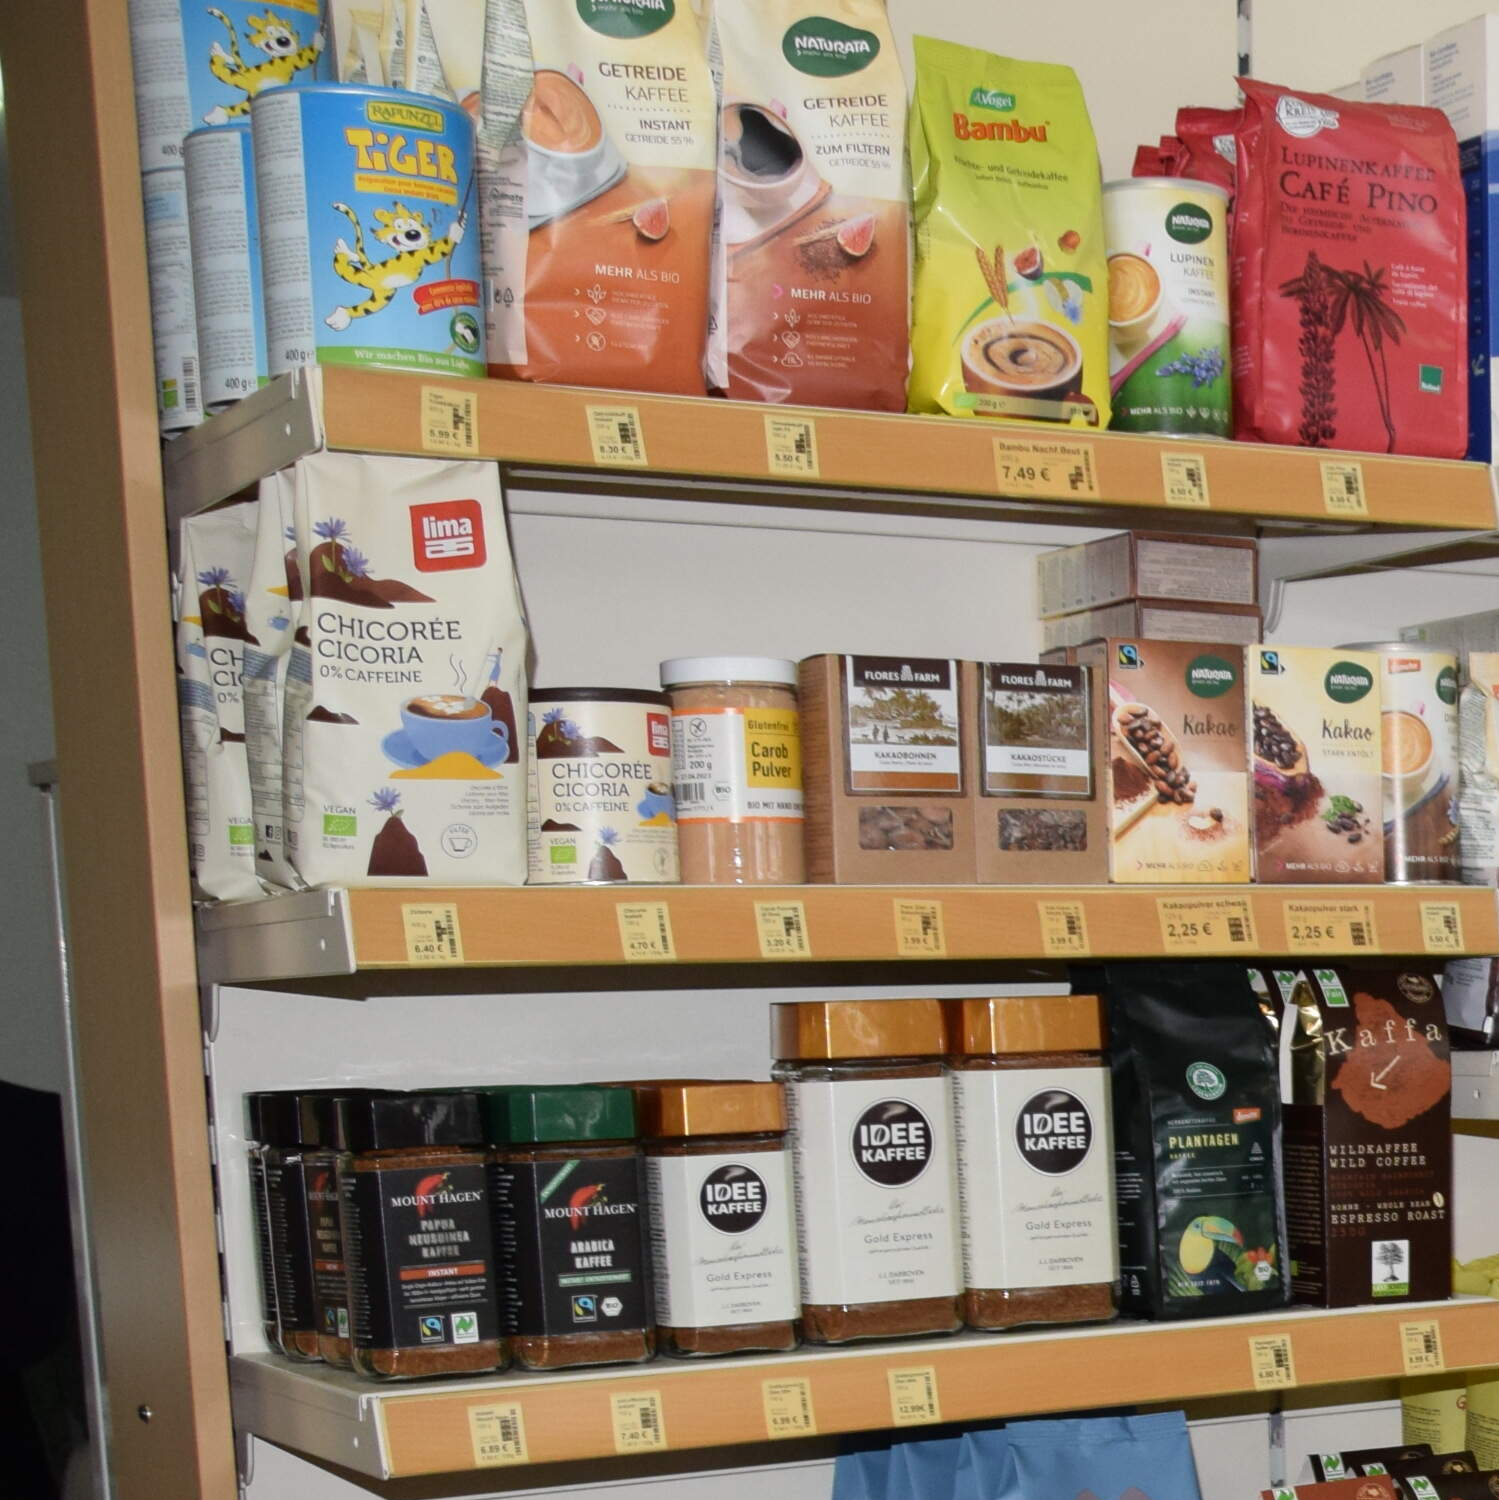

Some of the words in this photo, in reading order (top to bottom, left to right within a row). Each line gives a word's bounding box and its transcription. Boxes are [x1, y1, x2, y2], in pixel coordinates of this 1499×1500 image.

[795, 36, 869, 54] NATURATA
[600, 63, 687, 82] GETREIDE
[625, 87, 688, 103] KAFFEE
[640, 120, 691, 131] INSTANT
[954, 113, 1046, 142] Bambu
[816, 144, 843, 155] ZUM
[846, 144, 890, 156] FILTERN
[1282, 147, 1436, 182] LUPINENKAFFEE
[1280, 172, 1350, 205] CAFÉ
[1368, 182, 1437, 214] PINO
[1170, 253, 1214, 267] LUPINEN
[595, 265, 632, 278] MEHR
[637, 270, 658, 280] ALS
[661, 272, 679, 283] BIO
[1002, 466, 1035, 481] 7,49
[1040, 468, 1050, 481] €
[423, 514, 472, 538] lima
[317, 613, 461, 642] CHICORÉE
[318, 639, 423, 664] CICORIA
[319, 665, 342, 681] 0%
[344, 667, 422, 683] CAFFEINE
[865, 671, 900, 682] FLORES
[914, 672, 940, 683] FARM
[1183, 714, 1236, 737] Kakao
[751, 742, 788, 759] Carob
[874, 752, 937, 760] KAKAOBOHNEN
[1011, 752, 1067, 764] KAKAOSTÜCKE
[689, 760, 704, 769] 200
[752, 762, 791, 778] Pulver
[323, 805, 356, 815] VEGAN
[1168, 924, 1198, 938] 2,25
[1203, 924, 1212, 937] €
[1325, 1021, 1443, 1057] Kaffa
[860, 1122, 924, 1147] IDEE
[1168, 1132, 1239, 1149] PLANTAGEN
[861, 1146, 925, 1162] KAFFEE
[1329, 1143, 1417, 1155] WILDKAFFEE
[1329, 1158, 1366, 1168] WILD
[1376, 1155, 1426, 1166] COFFEE
[391, 1195, 435, 1208] MOUNT
[440, 1191, 481, 1203] HAGEN
[706, 1181, 760, 1202] IDEE
[545, 1208, 588, 1218] MOUNT
[593, 1204, 635, 1216] HAGEN
[707, 1201, 762, 1215] KAFFEE
[1331, 1213, 1399, 1224] ESPRESSO
[1407, 1210, 1445, 1221] ROAST
[571, 1240, 615, 1254] ARABICA
[576, 1255, 612, 1267] KAFFEE
[706, 1272, 730, 1282] Gold
[735, 1270, 773, 1283] Express
